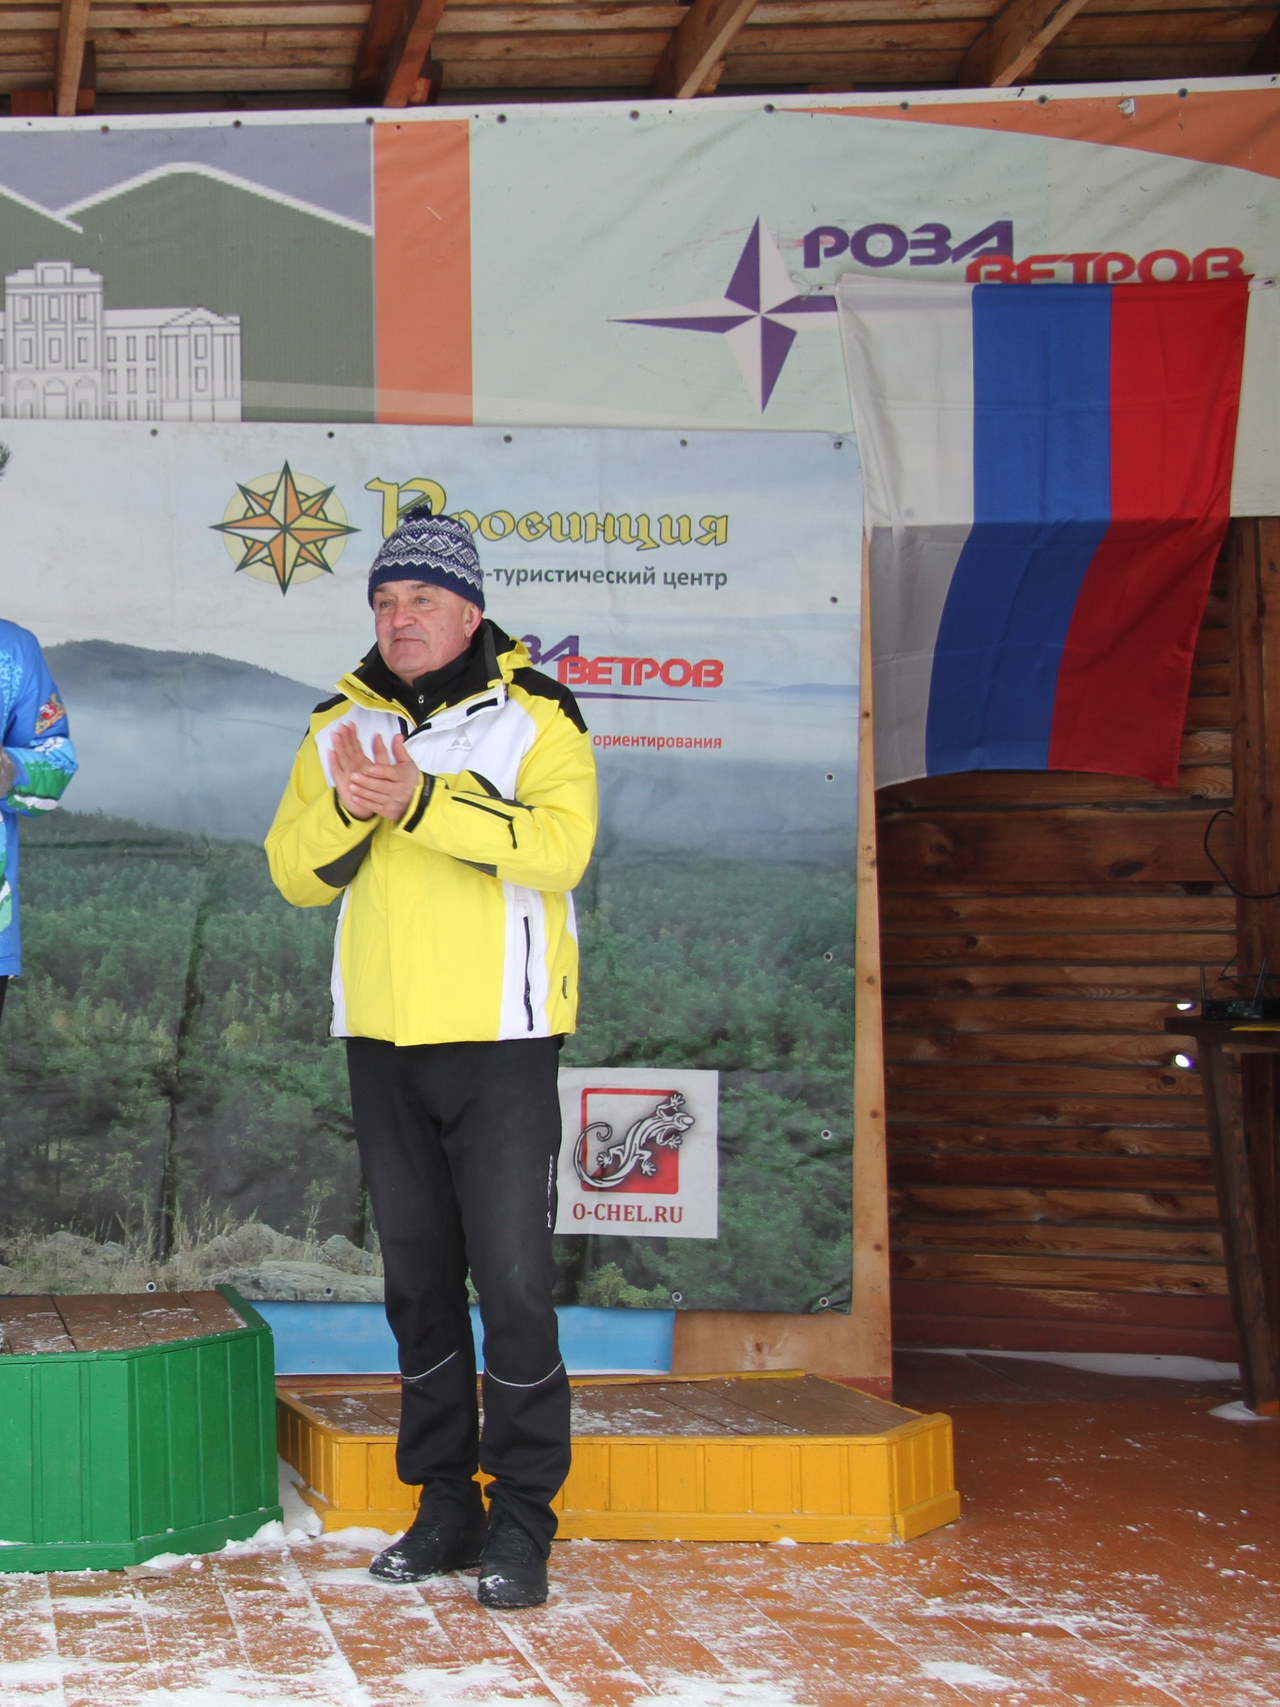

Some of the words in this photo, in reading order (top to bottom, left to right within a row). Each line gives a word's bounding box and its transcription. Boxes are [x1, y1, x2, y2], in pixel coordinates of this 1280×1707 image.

[803, 220, 1014, 269] РОЗА
[965, 247, 1245, 284] ВЕТРОВ
[663, 573, 728, 590] центр
[557, 656, 724, 688] ВЕТРОВ
[593, 733, 723, 750] ориентирования
[572, 1203, 684, 1224] O-CHEL.RU
